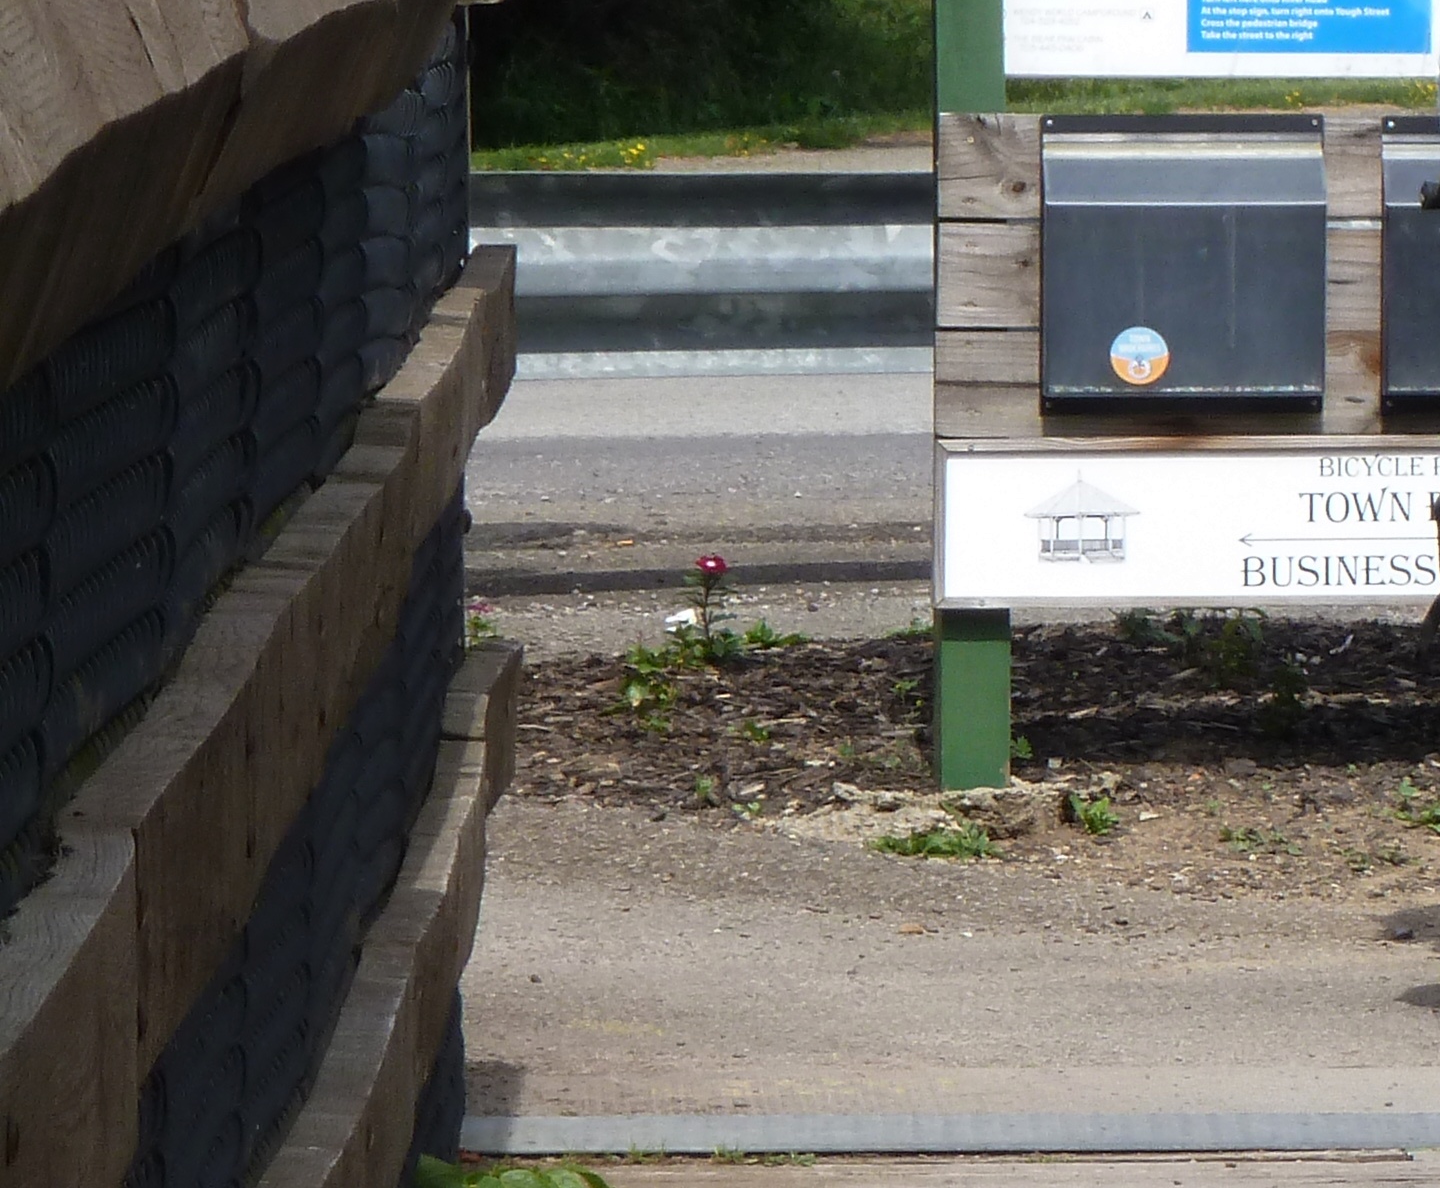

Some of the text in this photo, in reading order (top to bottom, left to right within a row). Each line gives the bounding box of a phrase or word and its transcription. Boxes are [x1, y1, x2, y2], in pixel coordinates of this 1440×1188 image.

[1201, 6, 1212, 15] At
[1212, 6, 1228, 15] the
[1228, 6, 1248, 17] stop
[1271, 7, 1290, 16] turn
[1290, 6, 1312, 18] right
[1313, 7, 1334, 16] onto
[1363, 6, 1390, 16] Street
[1201, 18, 1318, 30] Cross the pedestrian bridge
[1201, 30, 1314, 42] Take the street to the right
[1319, 454, 1424, 477] BICYCLE
[1299, 486, 1411, 523] TOWN
